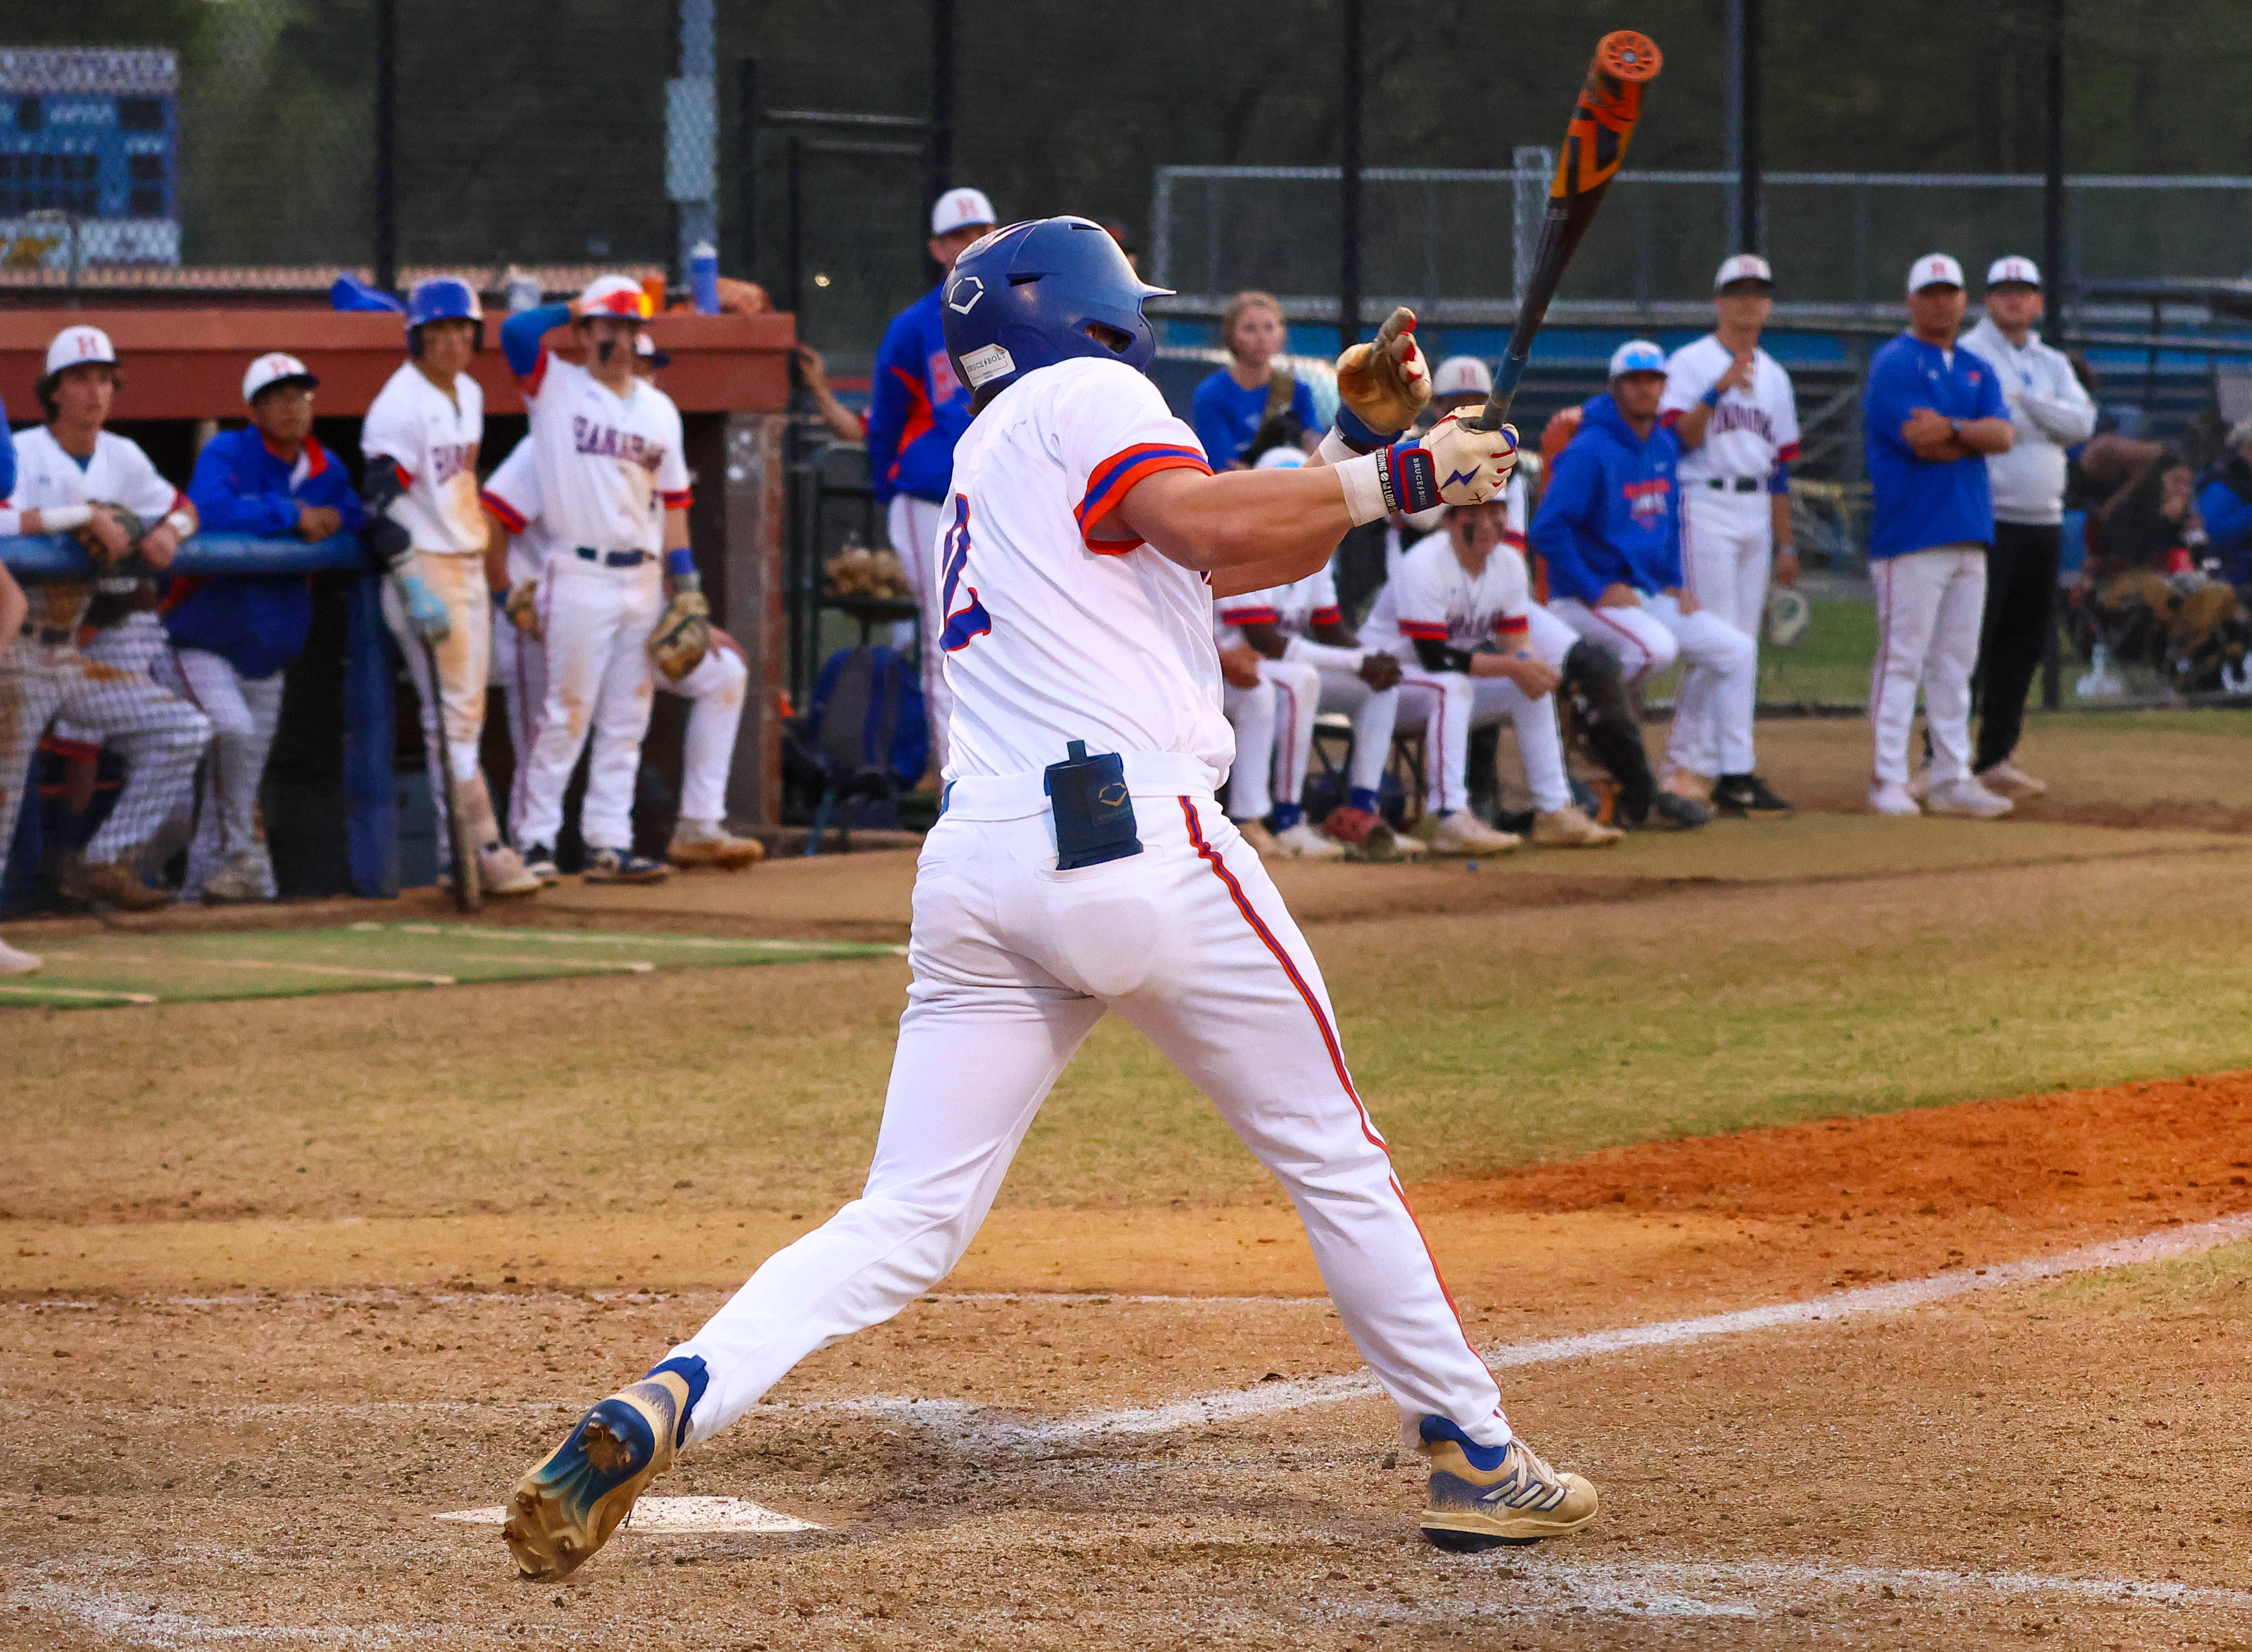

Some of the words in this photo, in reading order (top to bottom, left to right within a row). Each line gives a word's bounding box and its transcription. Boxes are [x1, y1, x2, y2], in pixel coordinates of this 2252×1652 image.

[987, 350, 1006, 364] BOLT
[1413, 457, 1424, 486] BRUCE
[1384, 490, 1396, 507] LORD
